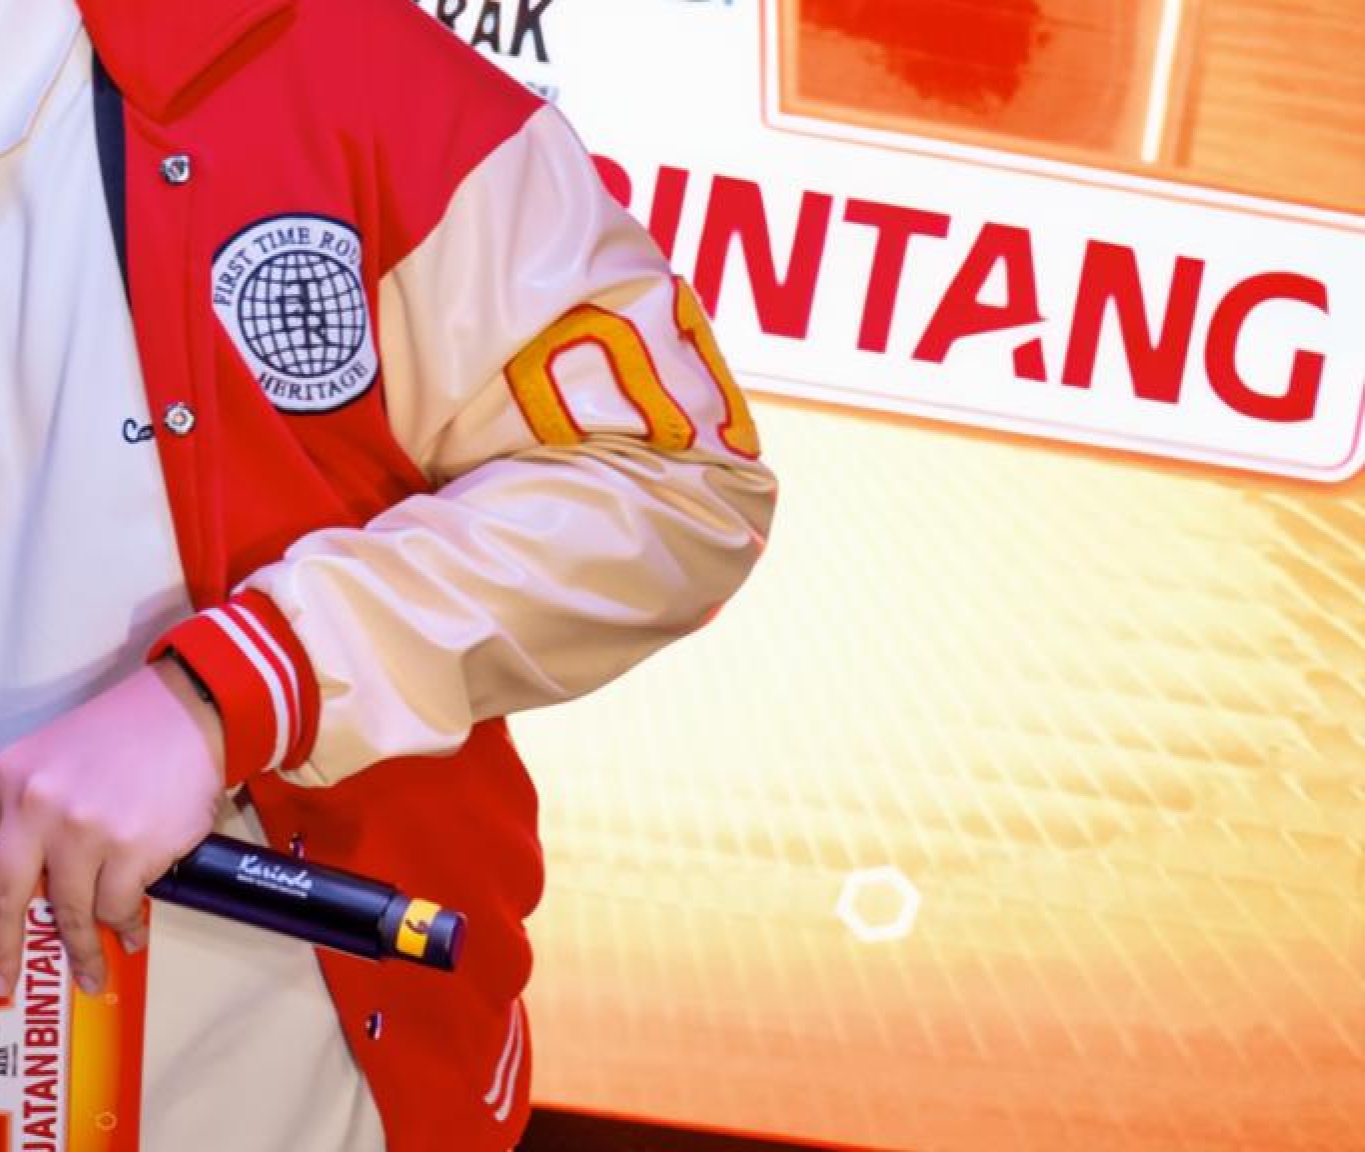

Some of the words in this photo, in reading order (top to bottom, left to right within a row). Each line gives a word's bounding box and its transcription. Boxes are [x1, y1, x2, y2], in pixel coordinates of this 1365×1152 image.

[213, 247, 254, 307] FIRST
[253, 226, 311, 255] TIME
[588, 153, 1330, 424] INTANG
[258, 359, 369, 401] HERITAGE
[25, 903, 62, 1047] BINTANG
